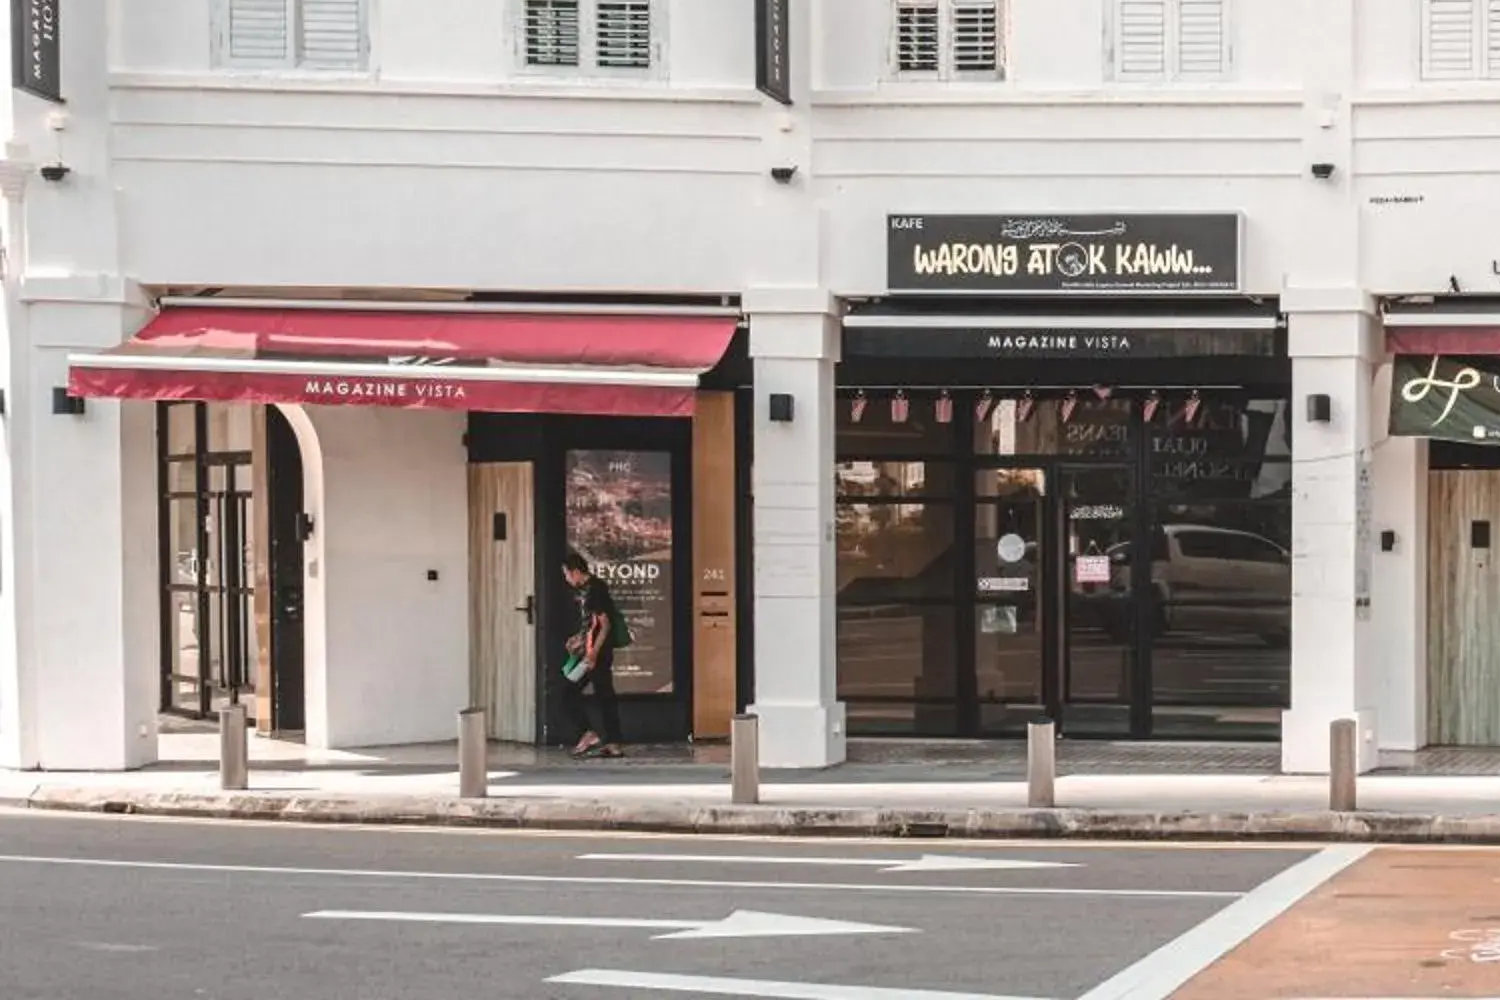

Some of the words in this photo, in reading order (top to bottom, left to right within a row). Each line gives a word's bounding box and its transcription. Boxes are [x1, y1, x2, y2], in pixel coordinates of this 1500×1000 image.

[891, 217, 924, 229] KAFE
[988, 335, 1077, 349] MAGAZINE
[1084, 335, 1130, 349] VISTA
[305, 381, 407, 397] MAGAZINE
[415, 384, 466, 398] VISTA
